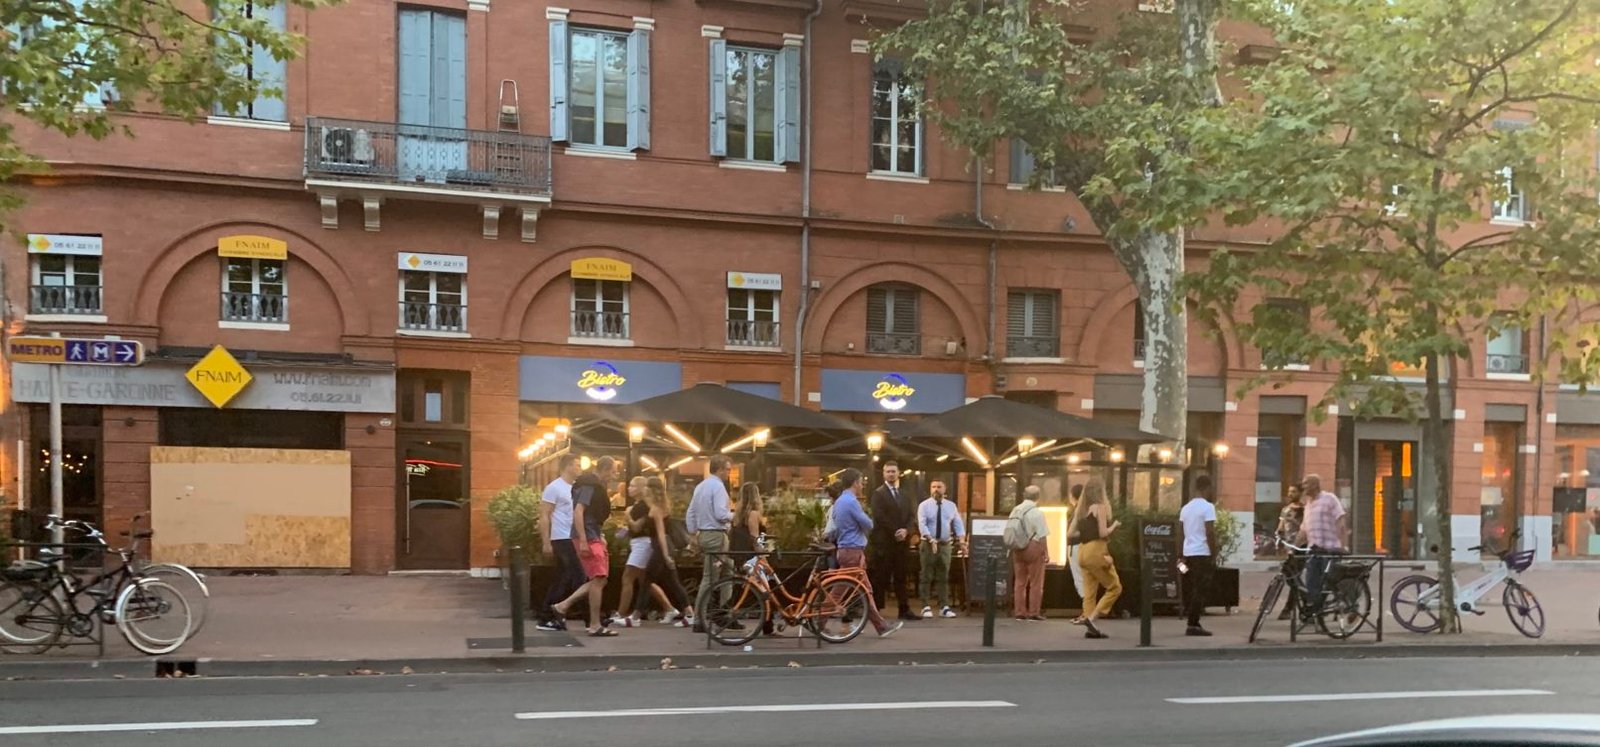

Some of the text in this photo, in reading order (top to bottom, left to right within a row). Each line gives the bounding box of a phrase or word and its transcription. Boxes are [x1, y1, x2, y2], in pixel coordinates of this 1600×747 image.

[11, 344, 63, 355] METRO
[195, 369, 242, 384] FNAIM
[578, 370, 626, 388] Bistro
[19, 379, 176, 401] HAE-GARONNE
[872, 381, 916, 399] Bistro
